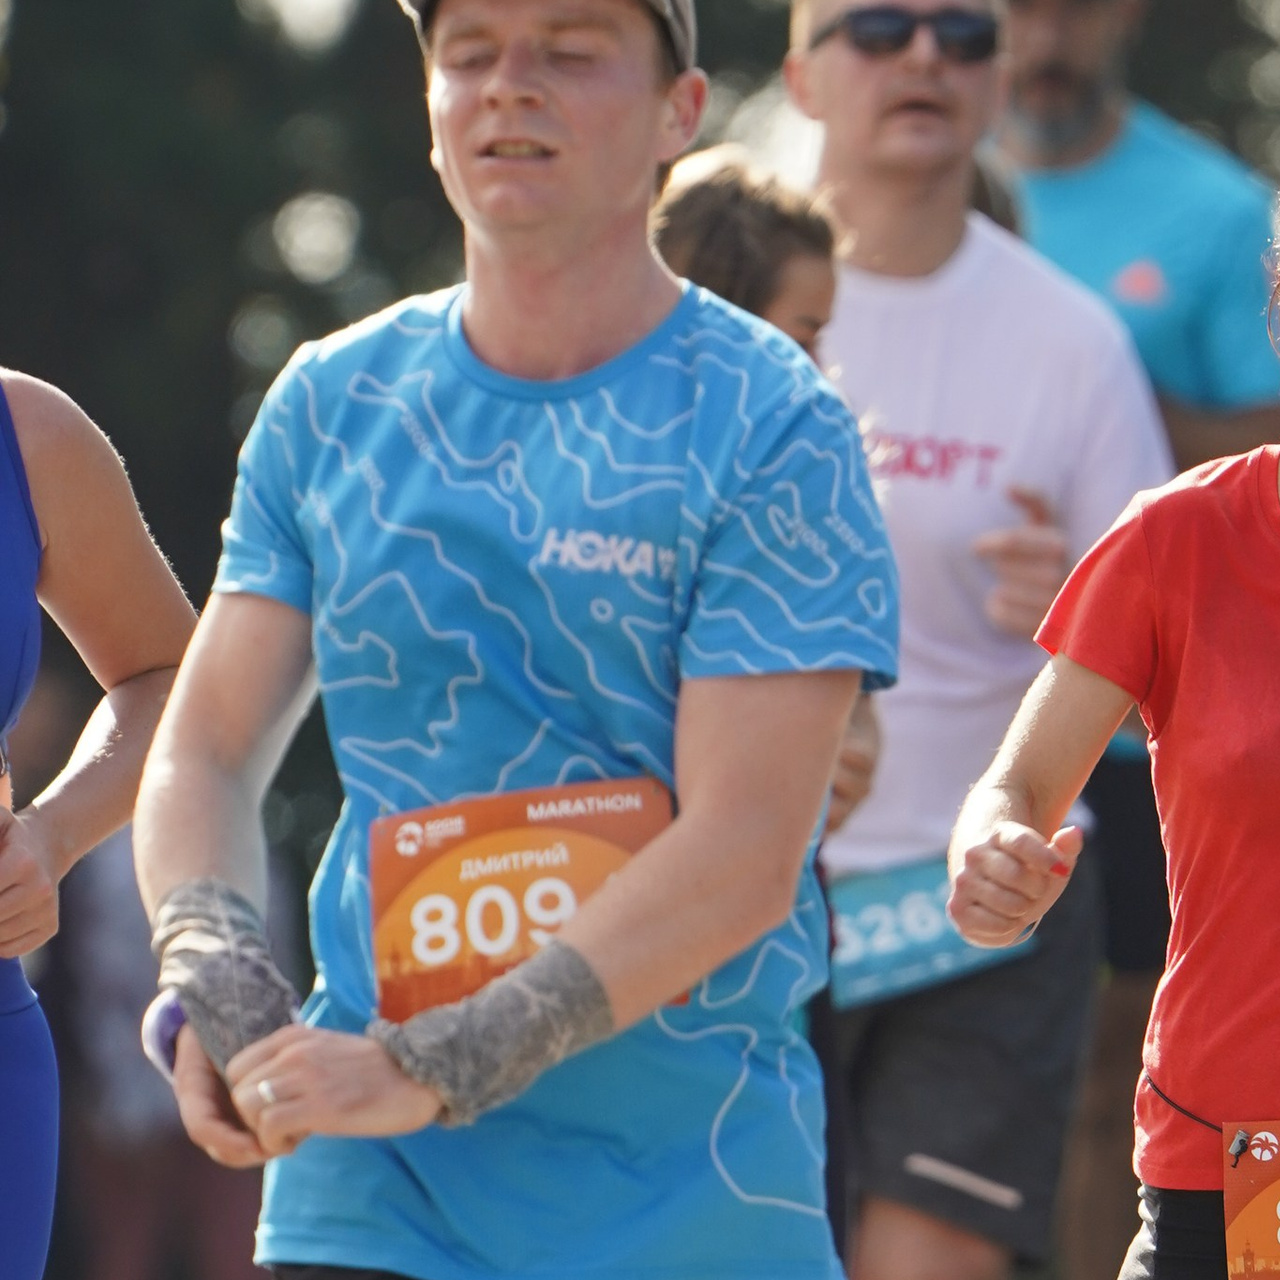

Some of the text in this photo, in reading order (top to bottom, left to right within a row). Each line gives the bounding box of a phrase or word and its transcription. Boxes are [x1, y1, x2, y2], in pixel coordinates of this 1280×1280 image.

[538, 527, 655, 578] HOKA
[526, 793, 642, 821] MARATHON
[459, 842, 570, 881] ДМИТРИЙ
